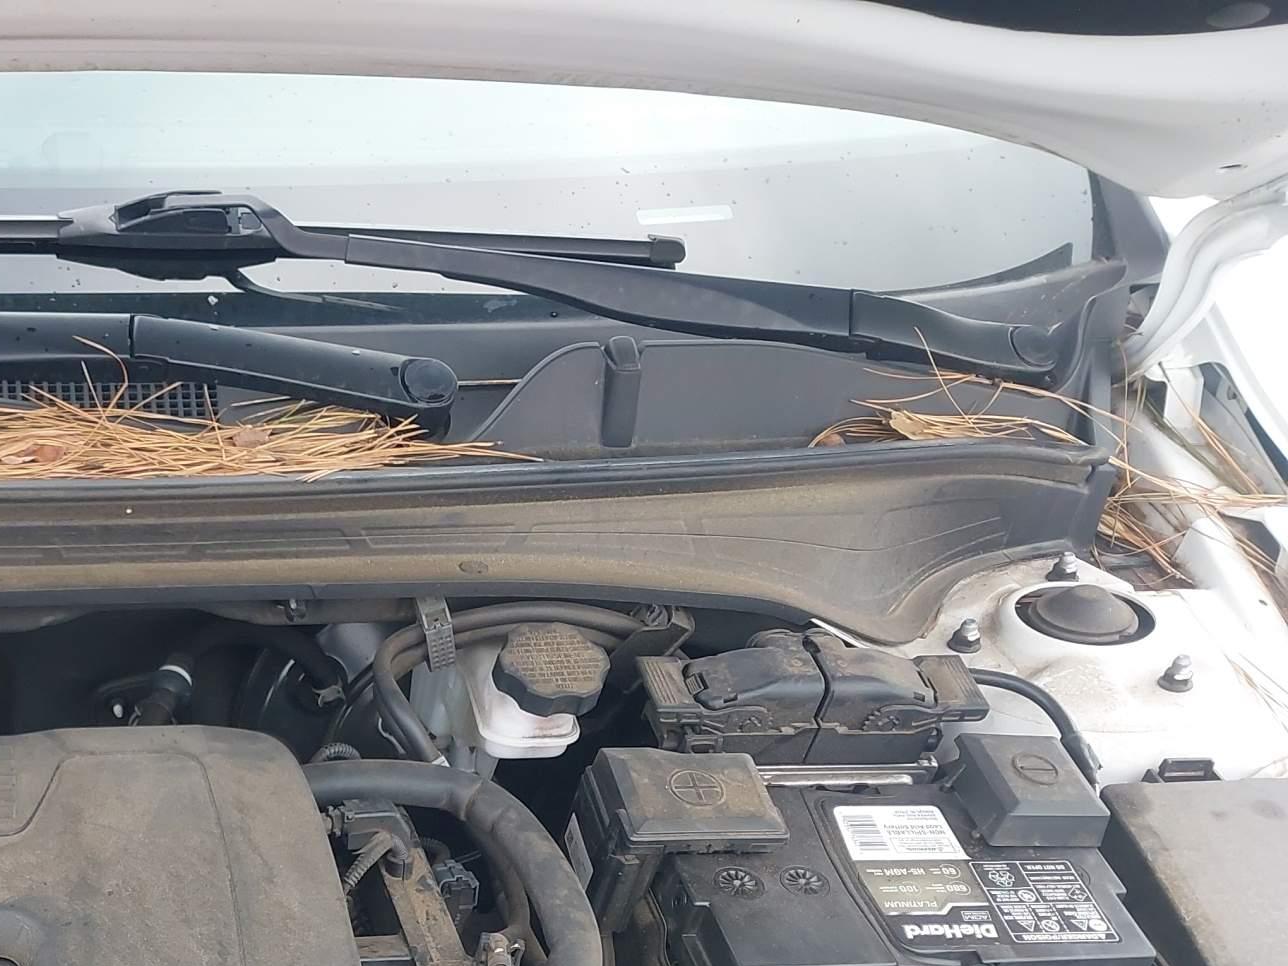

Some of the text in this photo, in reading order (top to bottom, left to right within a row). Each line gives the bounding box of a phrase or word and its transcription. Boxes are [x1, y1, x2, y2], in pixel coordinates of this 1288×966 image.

[941, 867, 957, 875] 60
[898, 885, 919, 893] 100
[945, 884, 967, 893] 680
[884, 900, 938, 908] PLATINUM
[904, 923, 998, 940] DieHard
